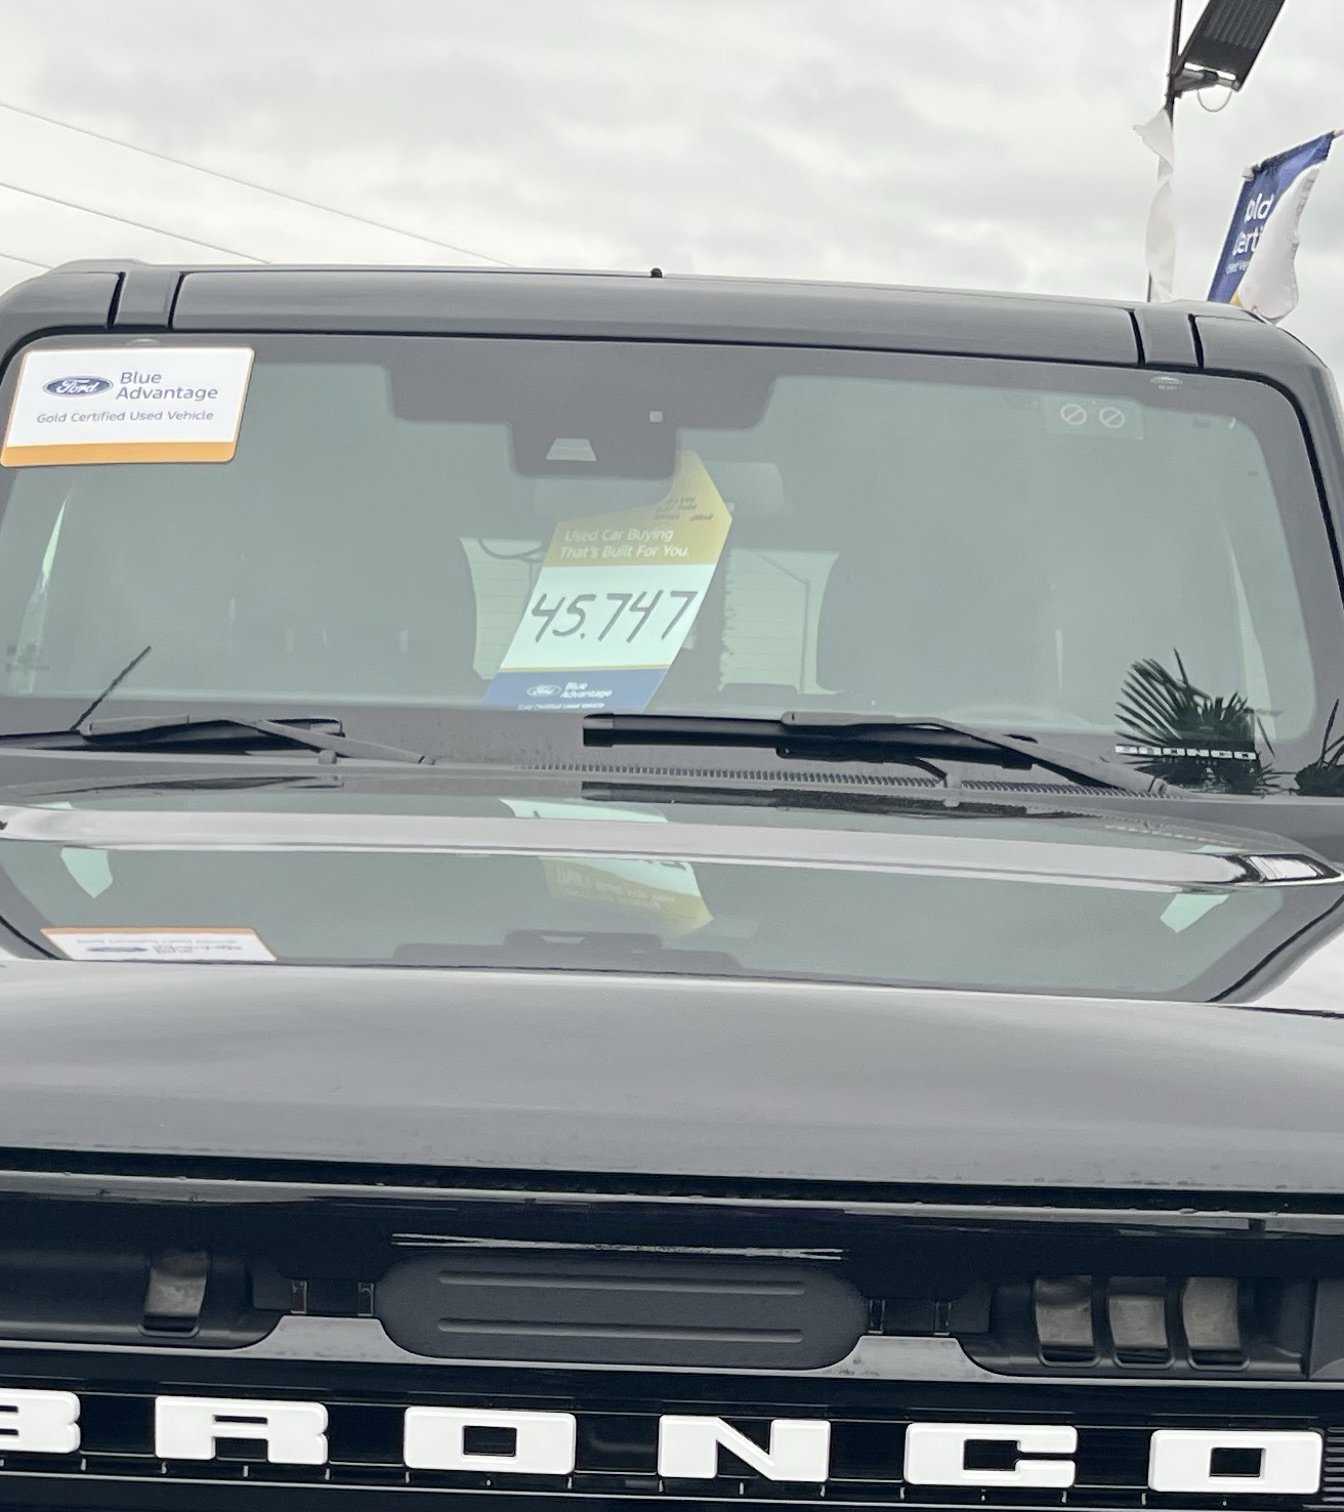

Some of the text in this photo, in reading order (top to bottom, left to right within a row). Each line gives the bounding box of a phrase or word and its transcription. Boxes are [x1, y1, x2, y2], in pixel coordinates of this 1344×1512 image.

[120, 371, 162, 385] Blue
[56, 378, 100, 394] Ford
[116, 386, 218, 402] Advantage
[37, 410, 214, 423] Gold Certified Used Vehicle
[564, 528, 674, 543] Used Car Buying
[560, 546, 599, 559] That's
[602, 544, 633, 558] Built
[635, 545, 658, 557] For
